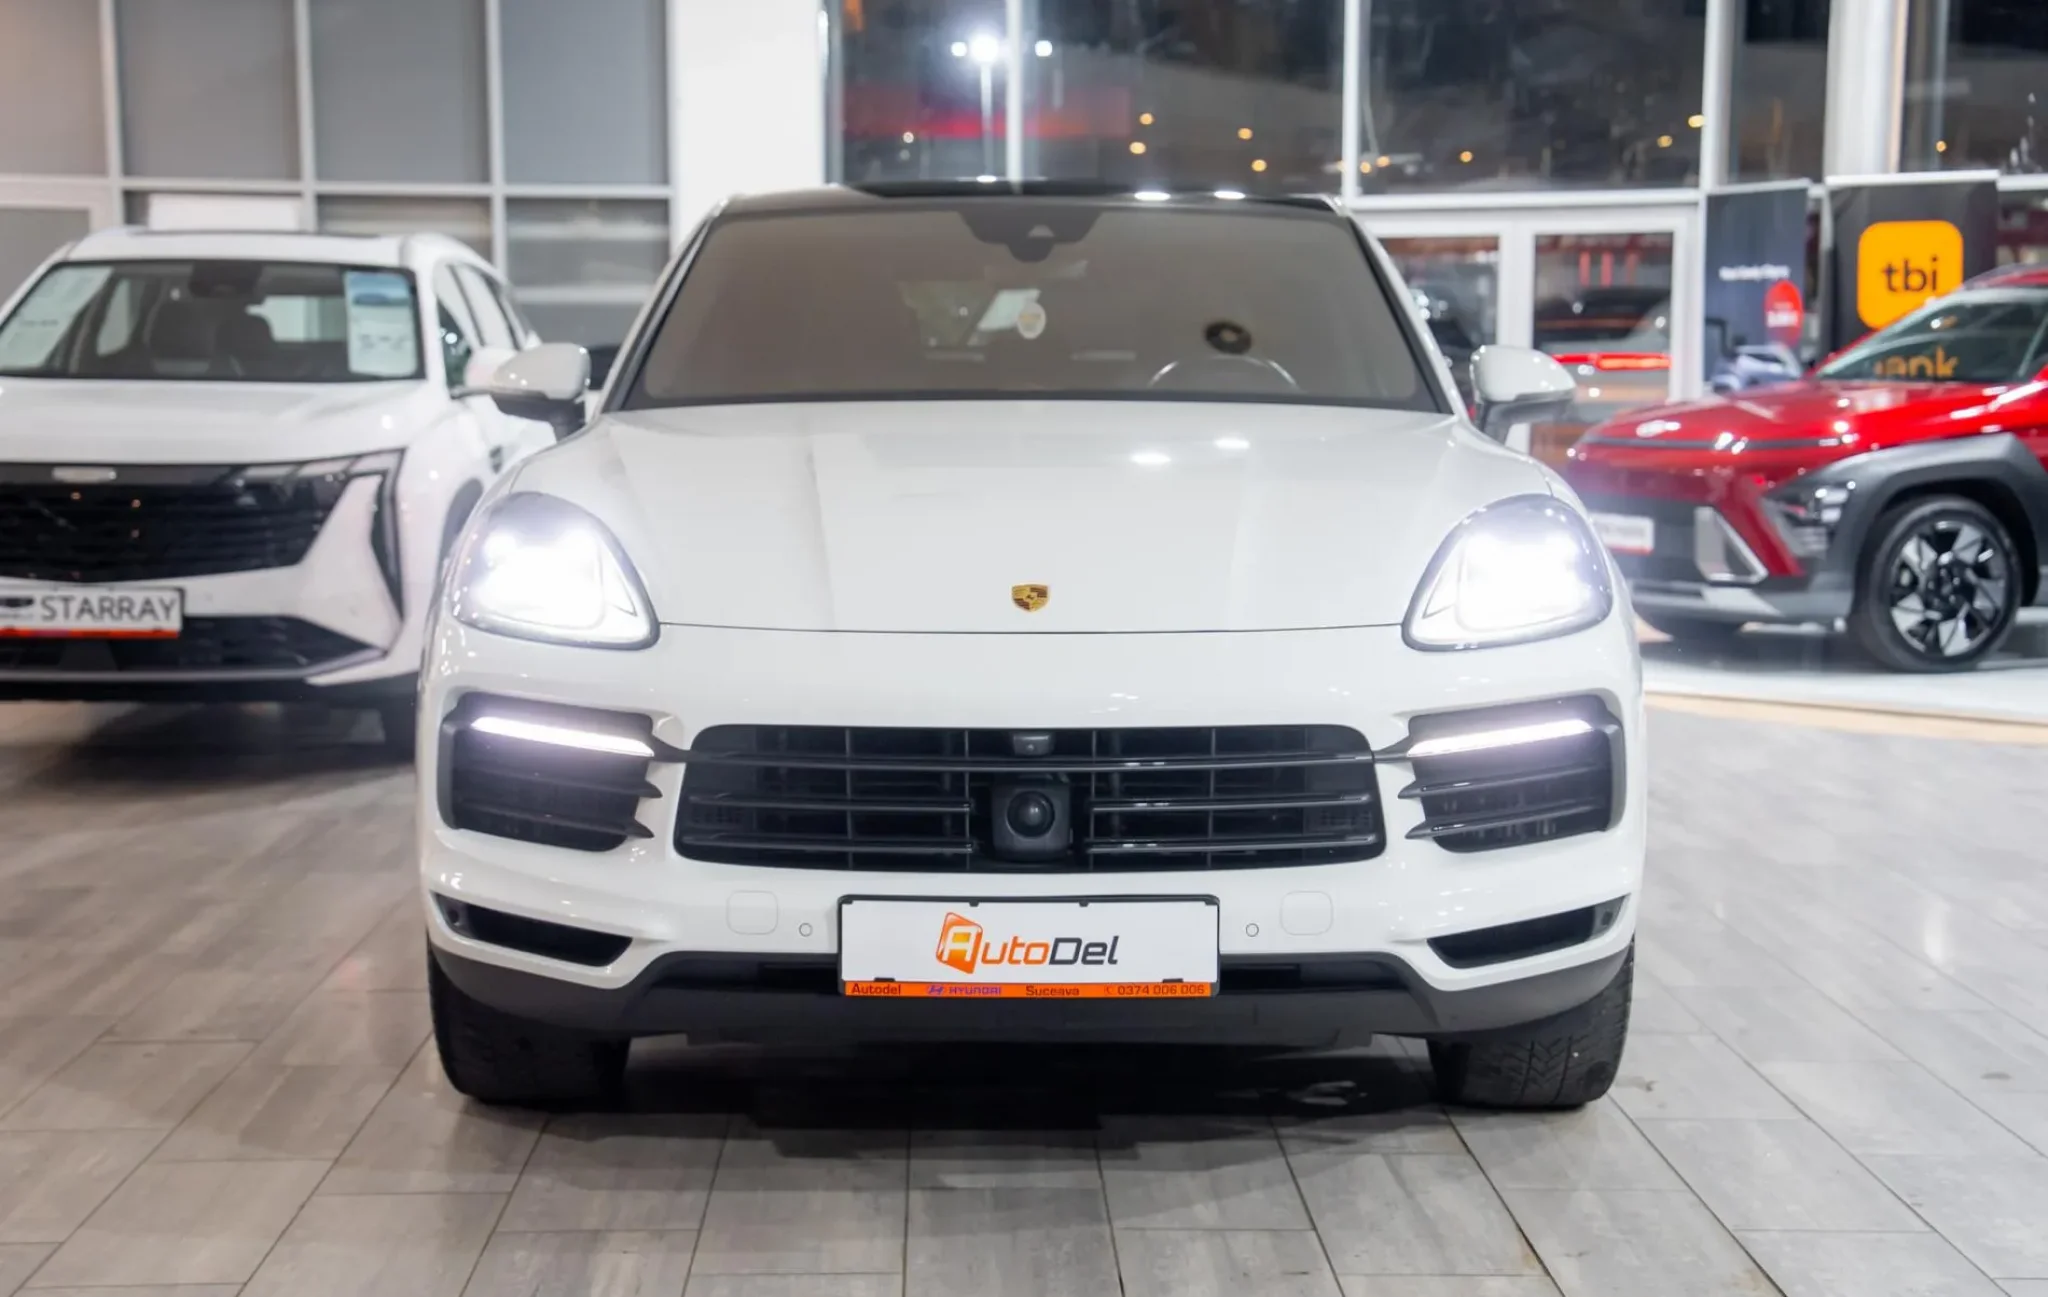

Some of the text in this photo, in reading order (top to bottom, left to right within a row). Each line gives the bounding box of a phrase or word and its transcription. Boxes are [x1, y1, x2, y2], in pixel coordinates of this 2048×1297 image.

[1881, 254, 1939, 293] tbi
[41, 595, 177, 621] STARRAY
[939, 919, 1120, 966] AutoDel
[851, 983, 901, 995] Autodel
[1025, 985, 1080, 996] Suceava
[1117, 985, 1150, 995] 0374
